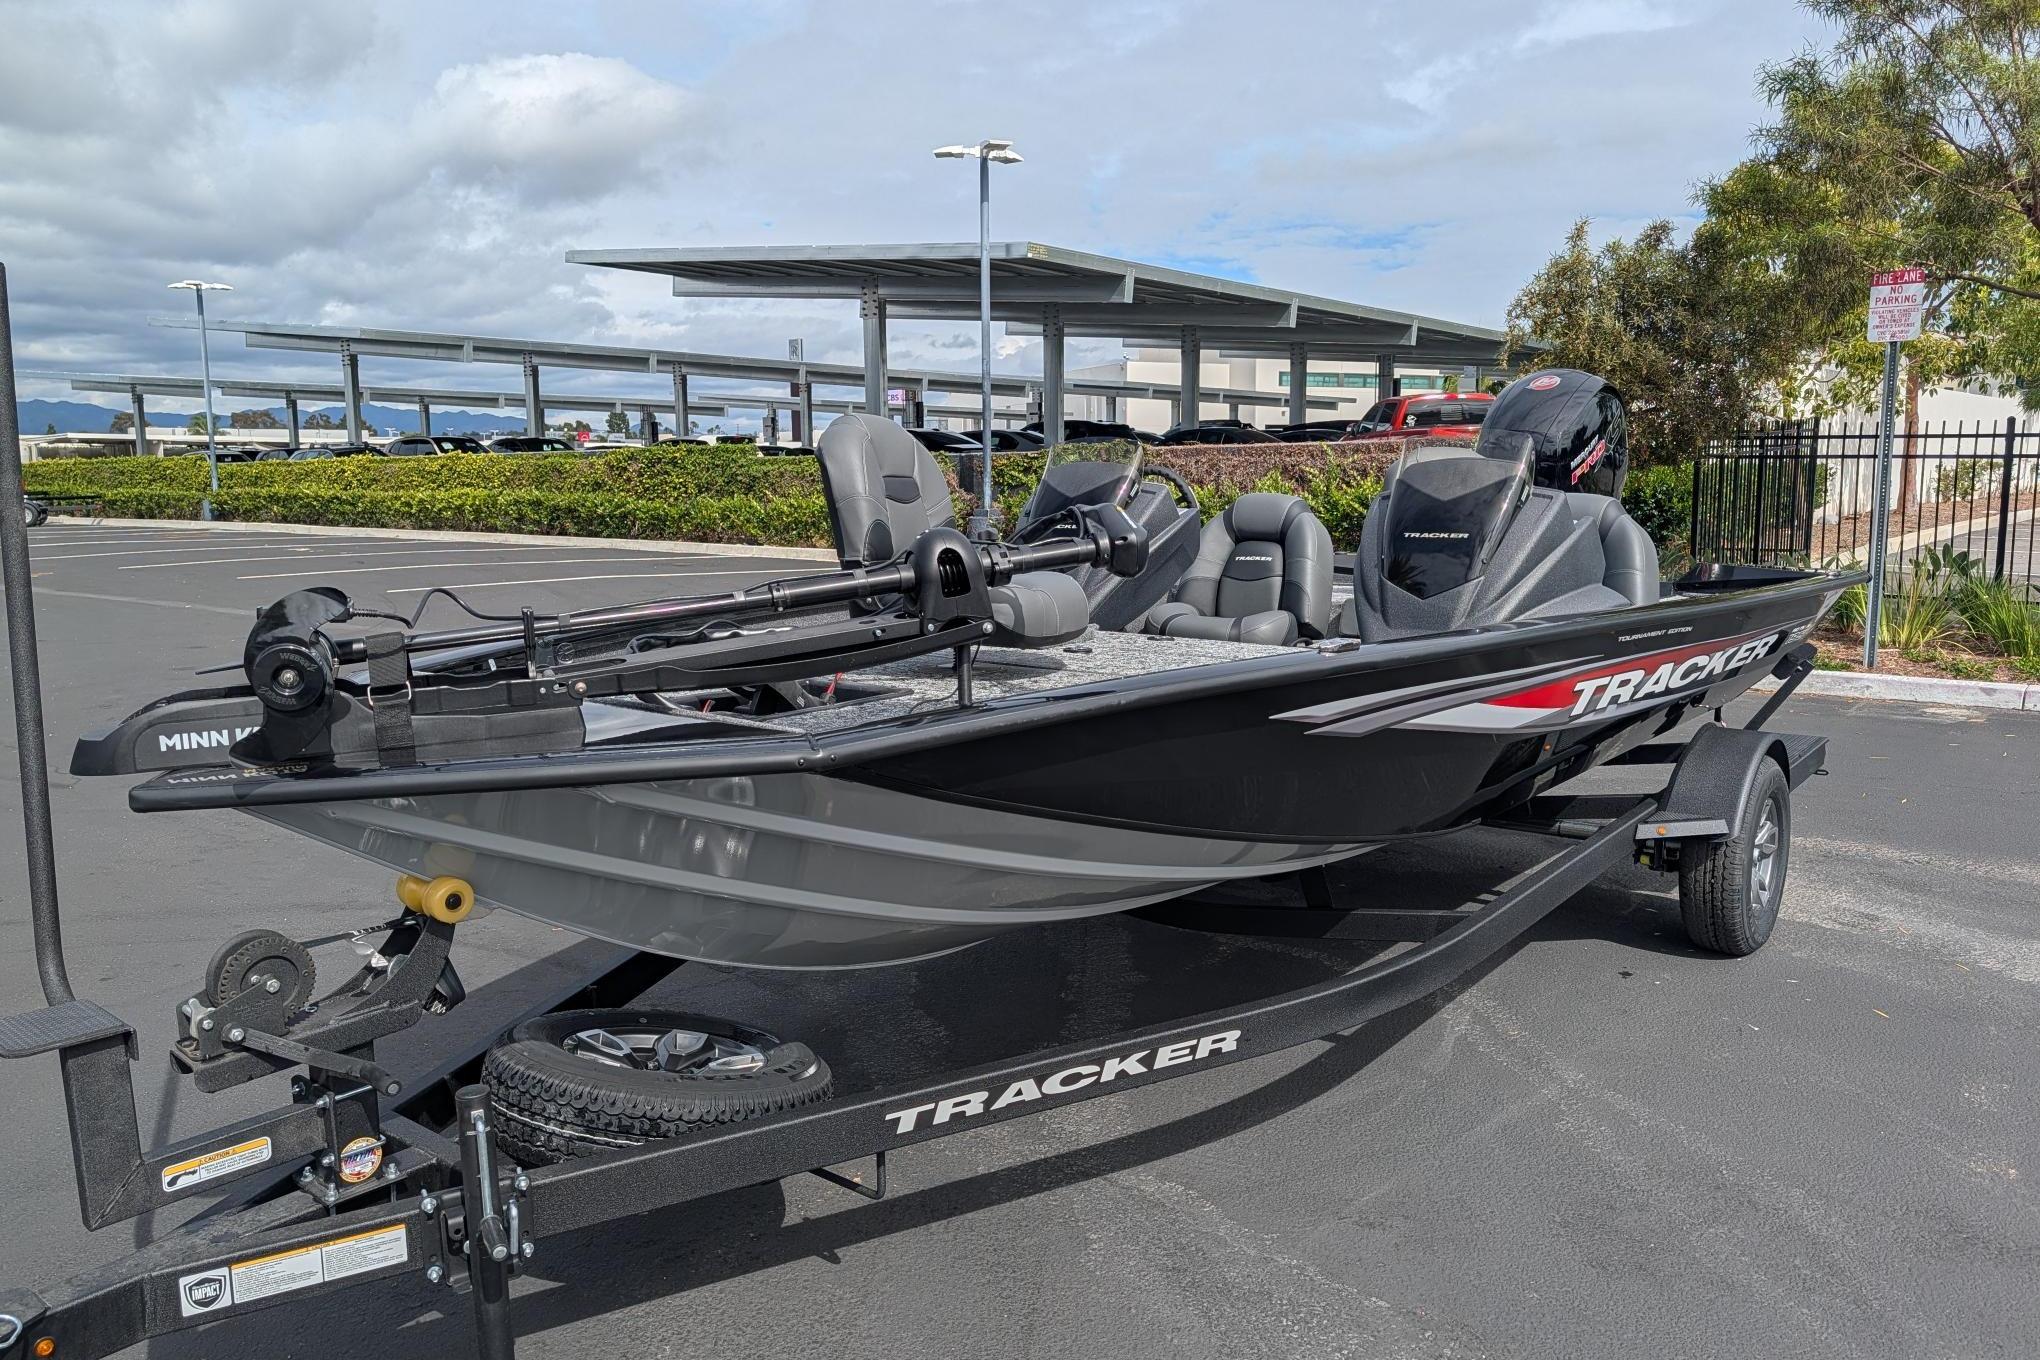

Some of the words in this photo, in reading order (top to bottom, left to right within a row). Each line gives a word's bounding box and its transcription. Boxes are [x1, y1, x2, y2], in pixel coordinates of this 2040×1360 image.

[1874, 274, 1893, 284] FIRE
[1898, 271, 1922, 282] LANE
[1890, 286, 1903, 295] NO
[1875, 295, 1917, 306] PARKING
[1618, 629, 1667, 642] TOURNAMENT
[1667, 626, 1693, 634] EDITION
[1569, 634, 1780, 718] TRACKER
[158, 729, 230, 752] MINN
[884, 1029, 1242, 1135] TRACKER
[204, 1151, 230, 1162] CAUTION
[192, 1284, 220, 1301] IMPACT
